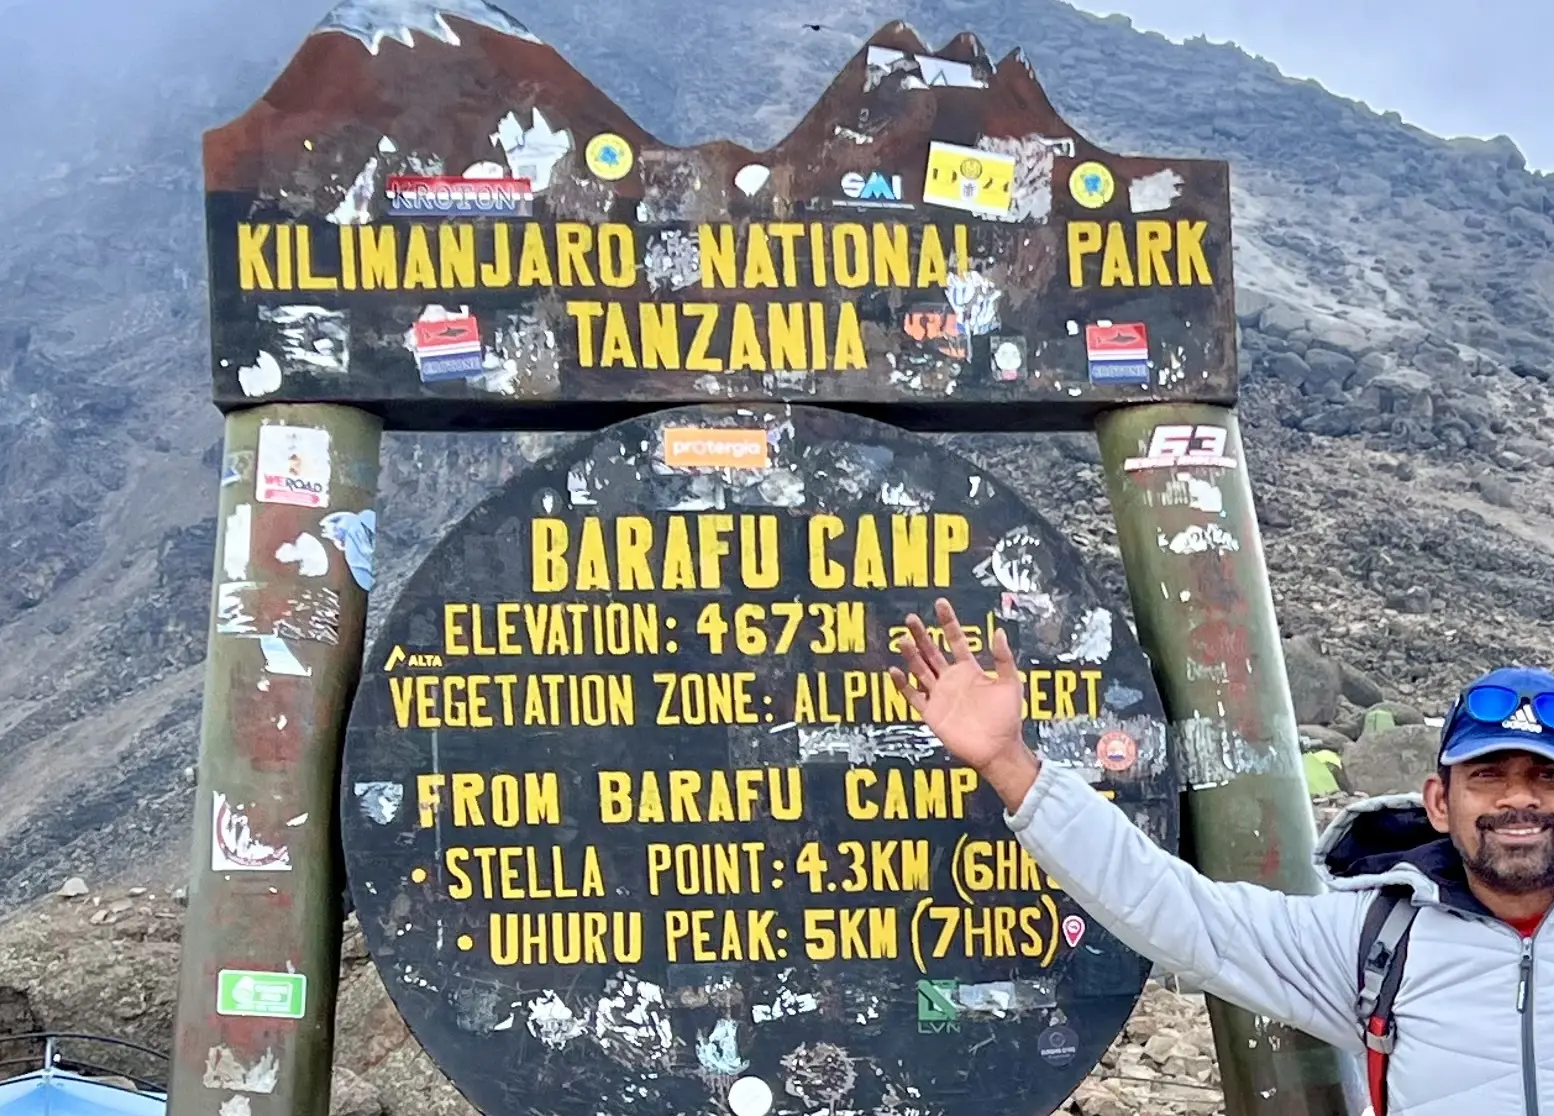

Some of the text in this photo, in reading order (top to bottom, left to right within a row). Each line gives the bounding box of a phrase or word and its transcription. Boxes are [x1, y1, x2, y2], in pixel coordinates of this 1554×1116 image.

[237, 221, 639, 291] KILIMANJARO
[1067, 219, 1214, 288] PARK
[566, 299, 869, 373] TANZANIA
[672, 440, 762, 458] protergia
[531, 512, 970, 593] BARAFU CAMP
[444, 602, 679, 657] ELEVATION:
[697, 600, 867, 656] 4673M
[417, 654, 443, 669] ALTA
[389, 671, 635, 729] VEGETATION
[655, 671, 776, 726] ZONE:
[416, 765, 979, 828] FROM BARAFU CAMP
[445, 844, 605, 901] STELLA
[796, 839, 931, 893] 4.3KM
[489, 910, 645, 966] UHURU
[803, 906, 899, 961] 5KM
[911, 893, 1059, 974] (7HRS)
